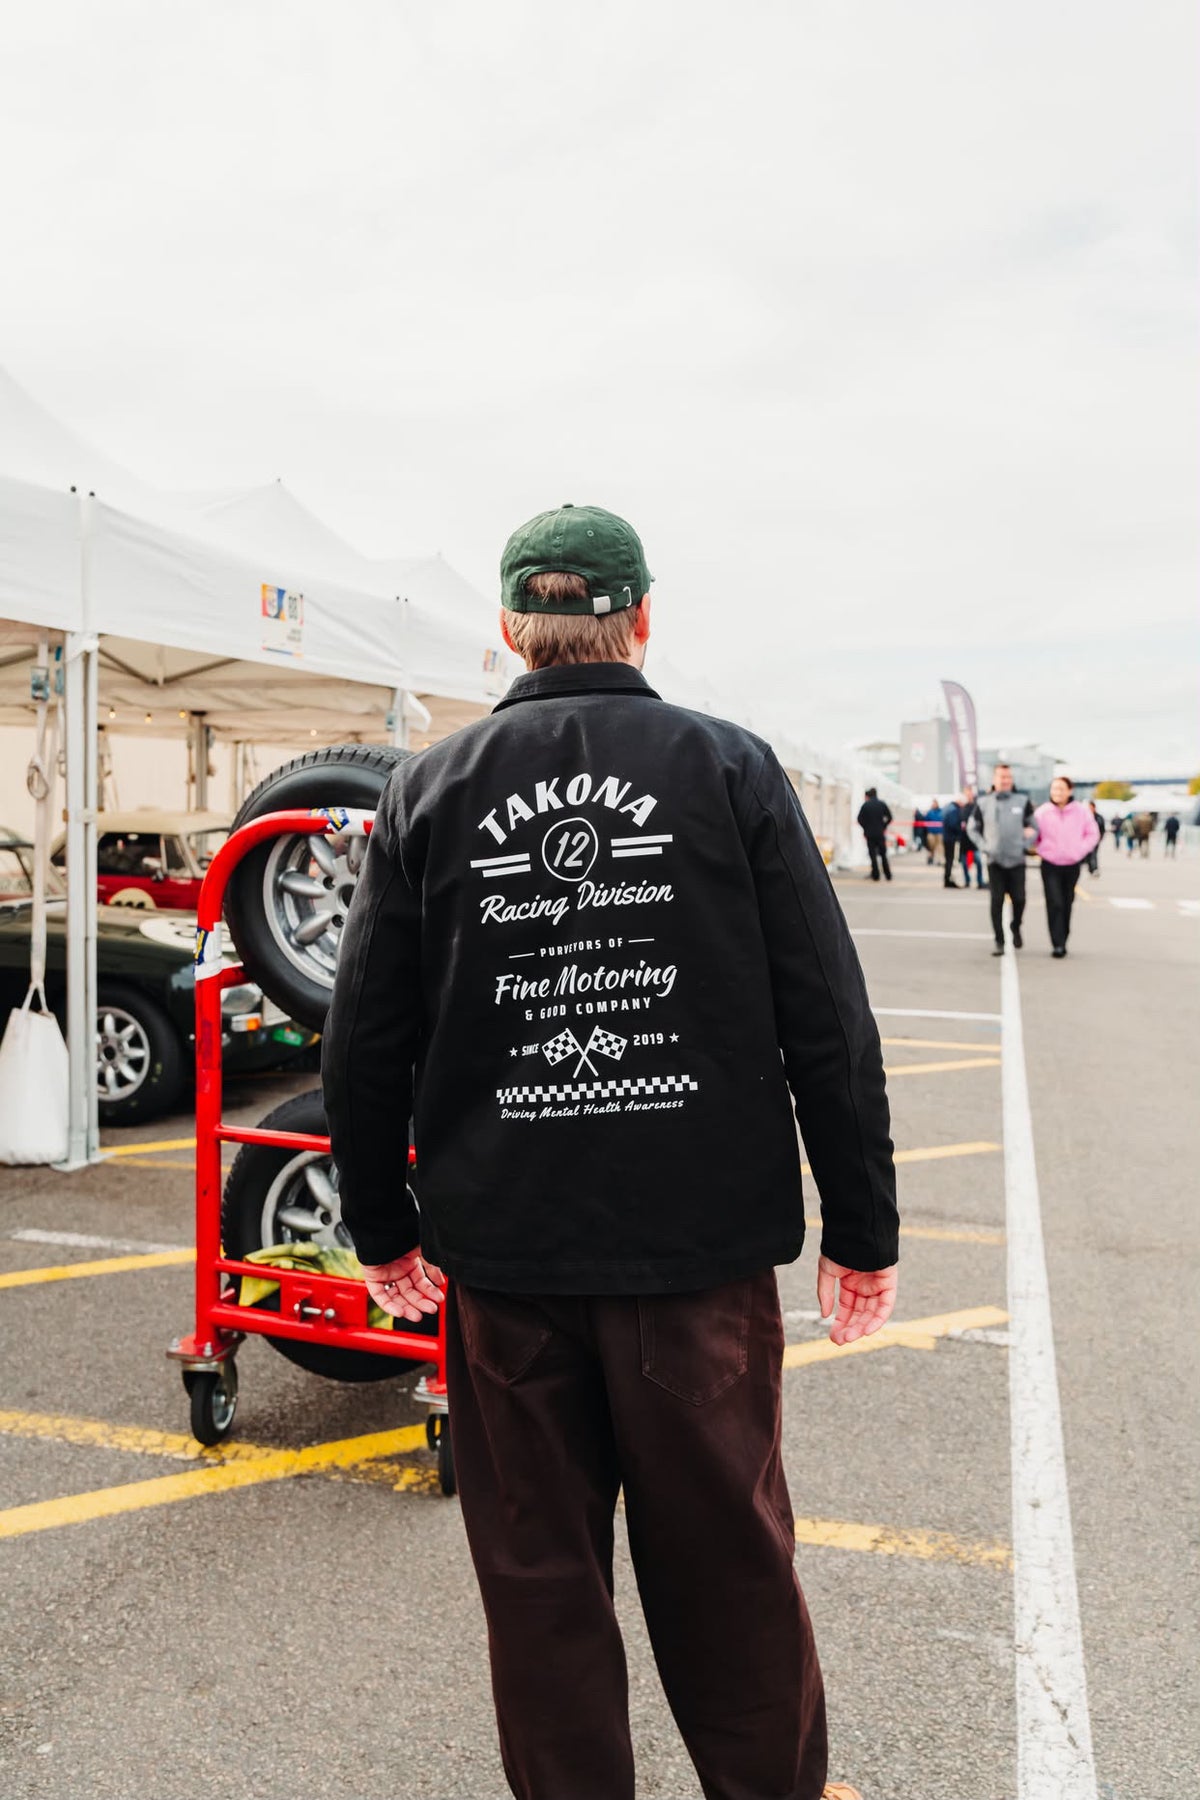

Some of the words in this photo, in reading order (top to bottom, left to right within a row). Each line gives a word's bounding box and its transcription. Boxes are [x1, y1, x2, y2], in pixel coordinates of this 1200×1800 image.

[478, 773, 657, 845] TAKONA
[554, 832, 590, 867] 12
[480, 895, 569, 925] Racing
[577, 880, 674, 910] Division
[540, 940, 601, 958] PURVEYORS
[608, 937, 623, 949] OF
[495, 974, 550, 1004] Fine
[554, 960, 677, 997] Motoring
[525, 1009, 533, 1021] &
[540, 1005, 567, 1020] GOOD
[576, 997, 651, 1015] COMPANY
[521, 1043, 540, 1057] SINCE
[633, 1033, 664, 1046] 2019
[501, 1109, 537, 1121] Driving
[539, 1105, 580, 1119] Mental
[583, 1100, 621, 1115] Health
[625, 1099, 685, 1112] Awareness
